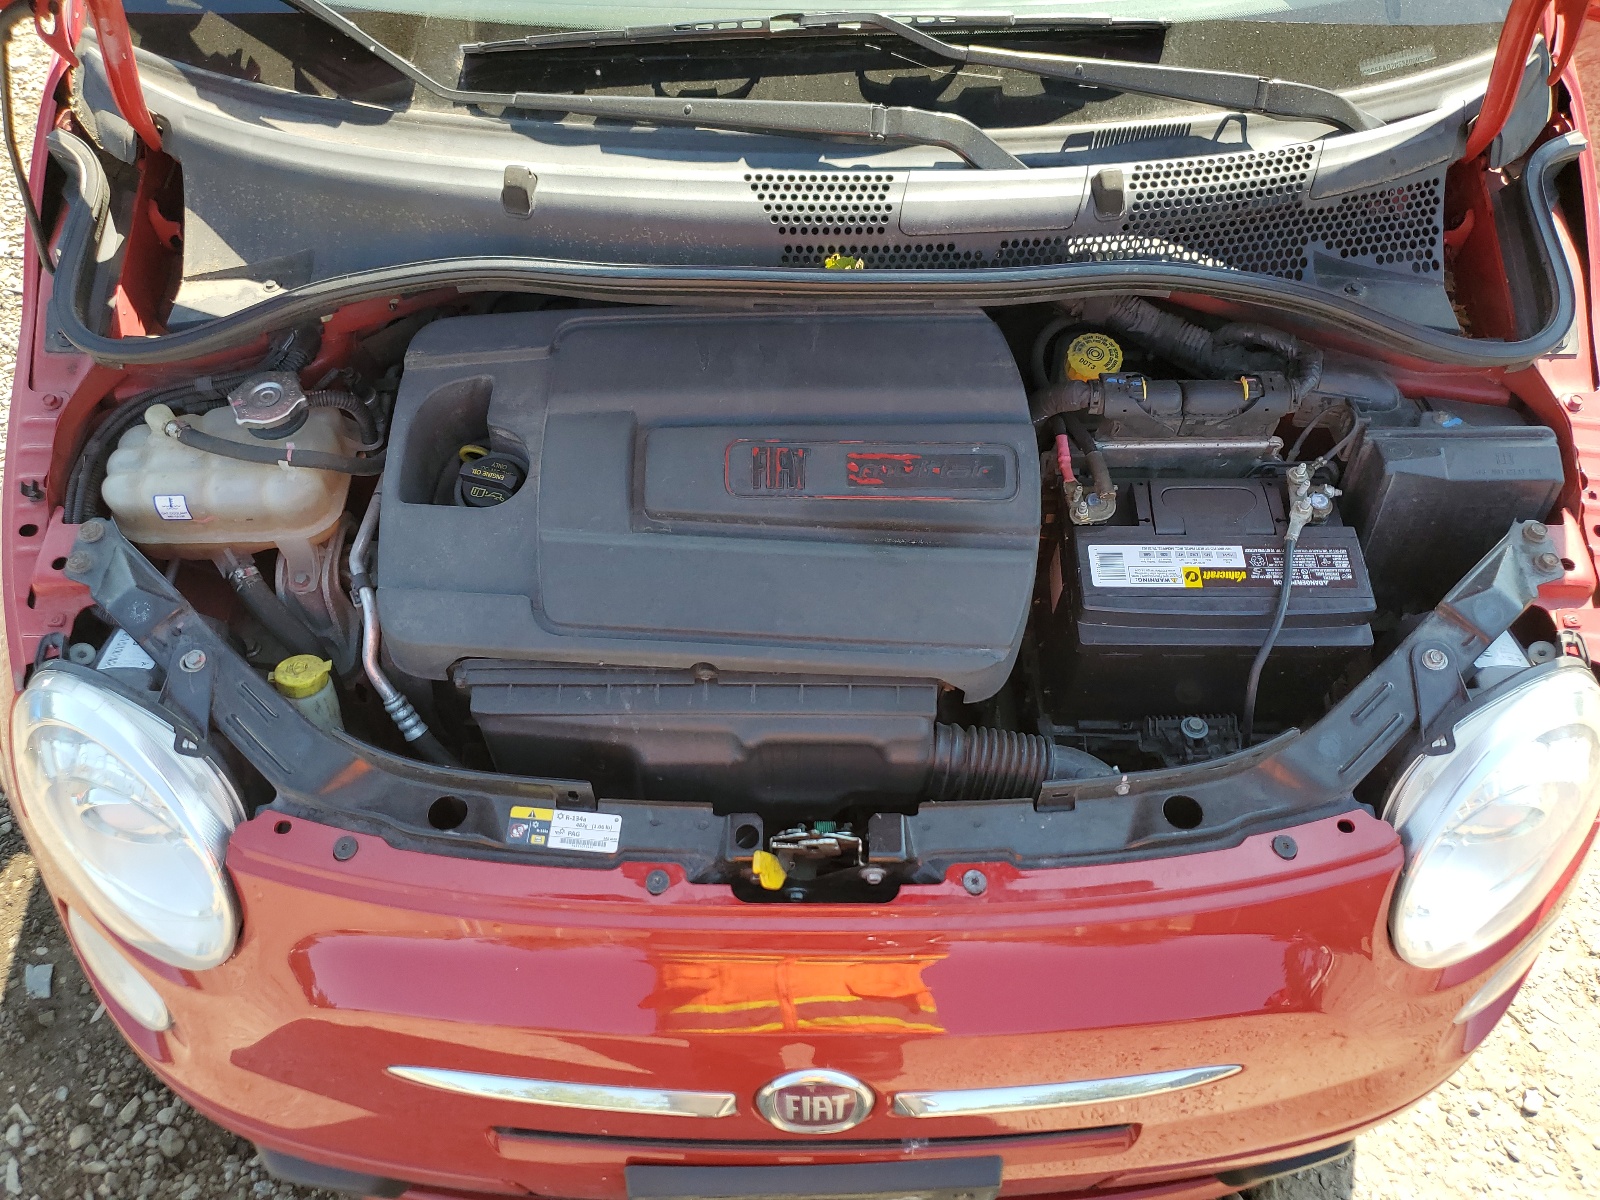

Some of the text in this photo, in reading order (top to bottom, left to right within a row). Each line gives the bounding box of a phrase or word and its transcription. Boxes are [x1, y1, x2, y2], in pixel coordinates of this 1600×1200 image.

[482, 471, 505, 481] ENGINE
[751, 447, 811, 489] FIAT
[786, 1094, 850, 1121] FIAT
